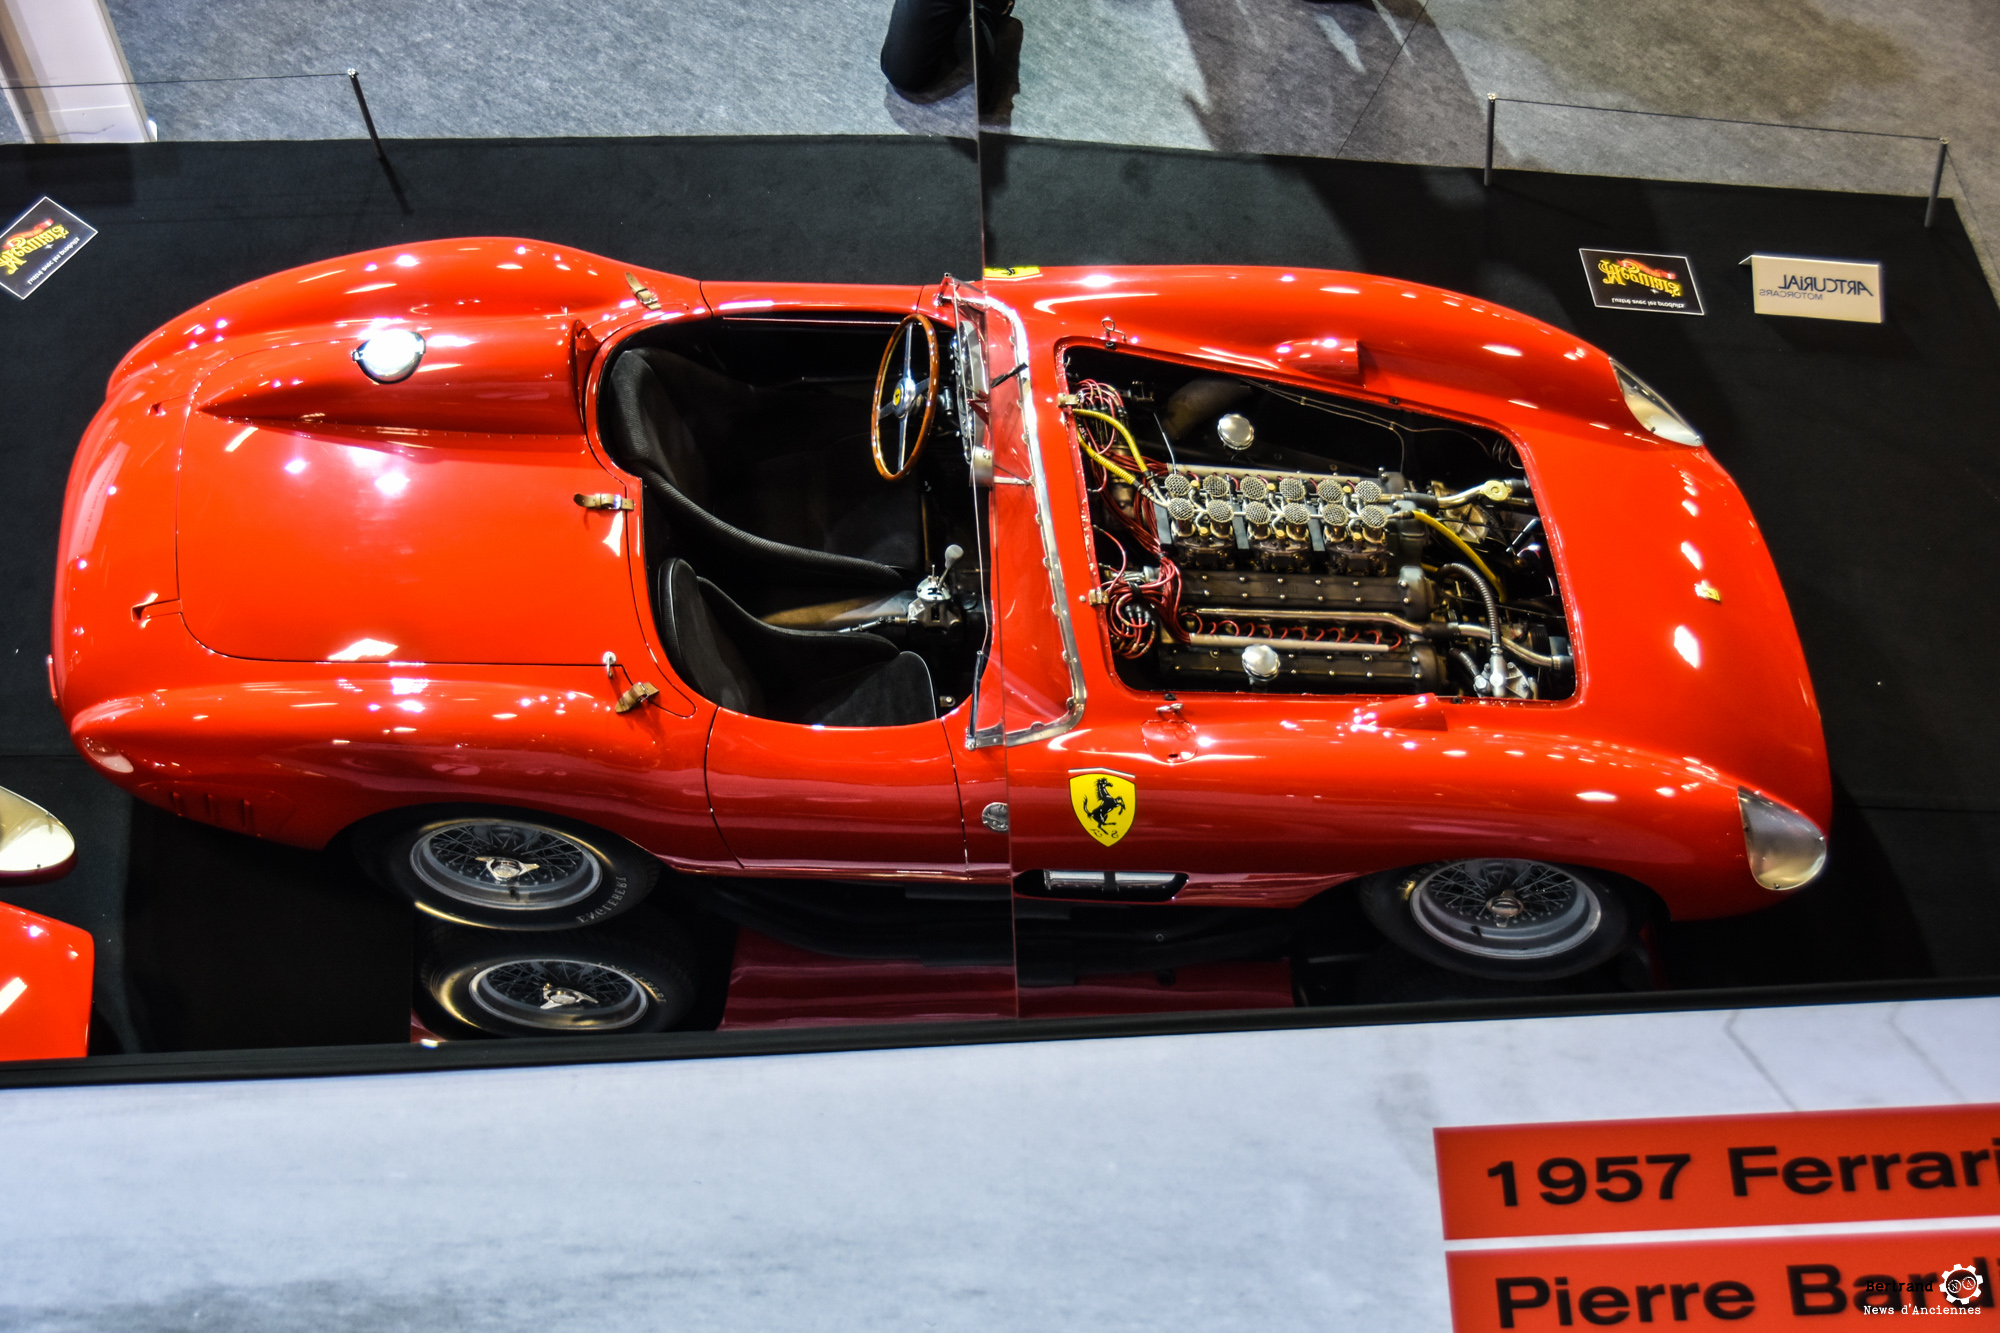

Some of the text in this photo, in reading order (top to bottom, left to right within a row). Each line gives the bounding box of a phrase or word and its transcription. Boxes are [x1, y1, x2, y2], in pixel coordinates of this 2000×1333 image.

[1487, 1153, 1691, 1207] 1957
[1496, 1256, 2000, 1329] Pierre Bard
